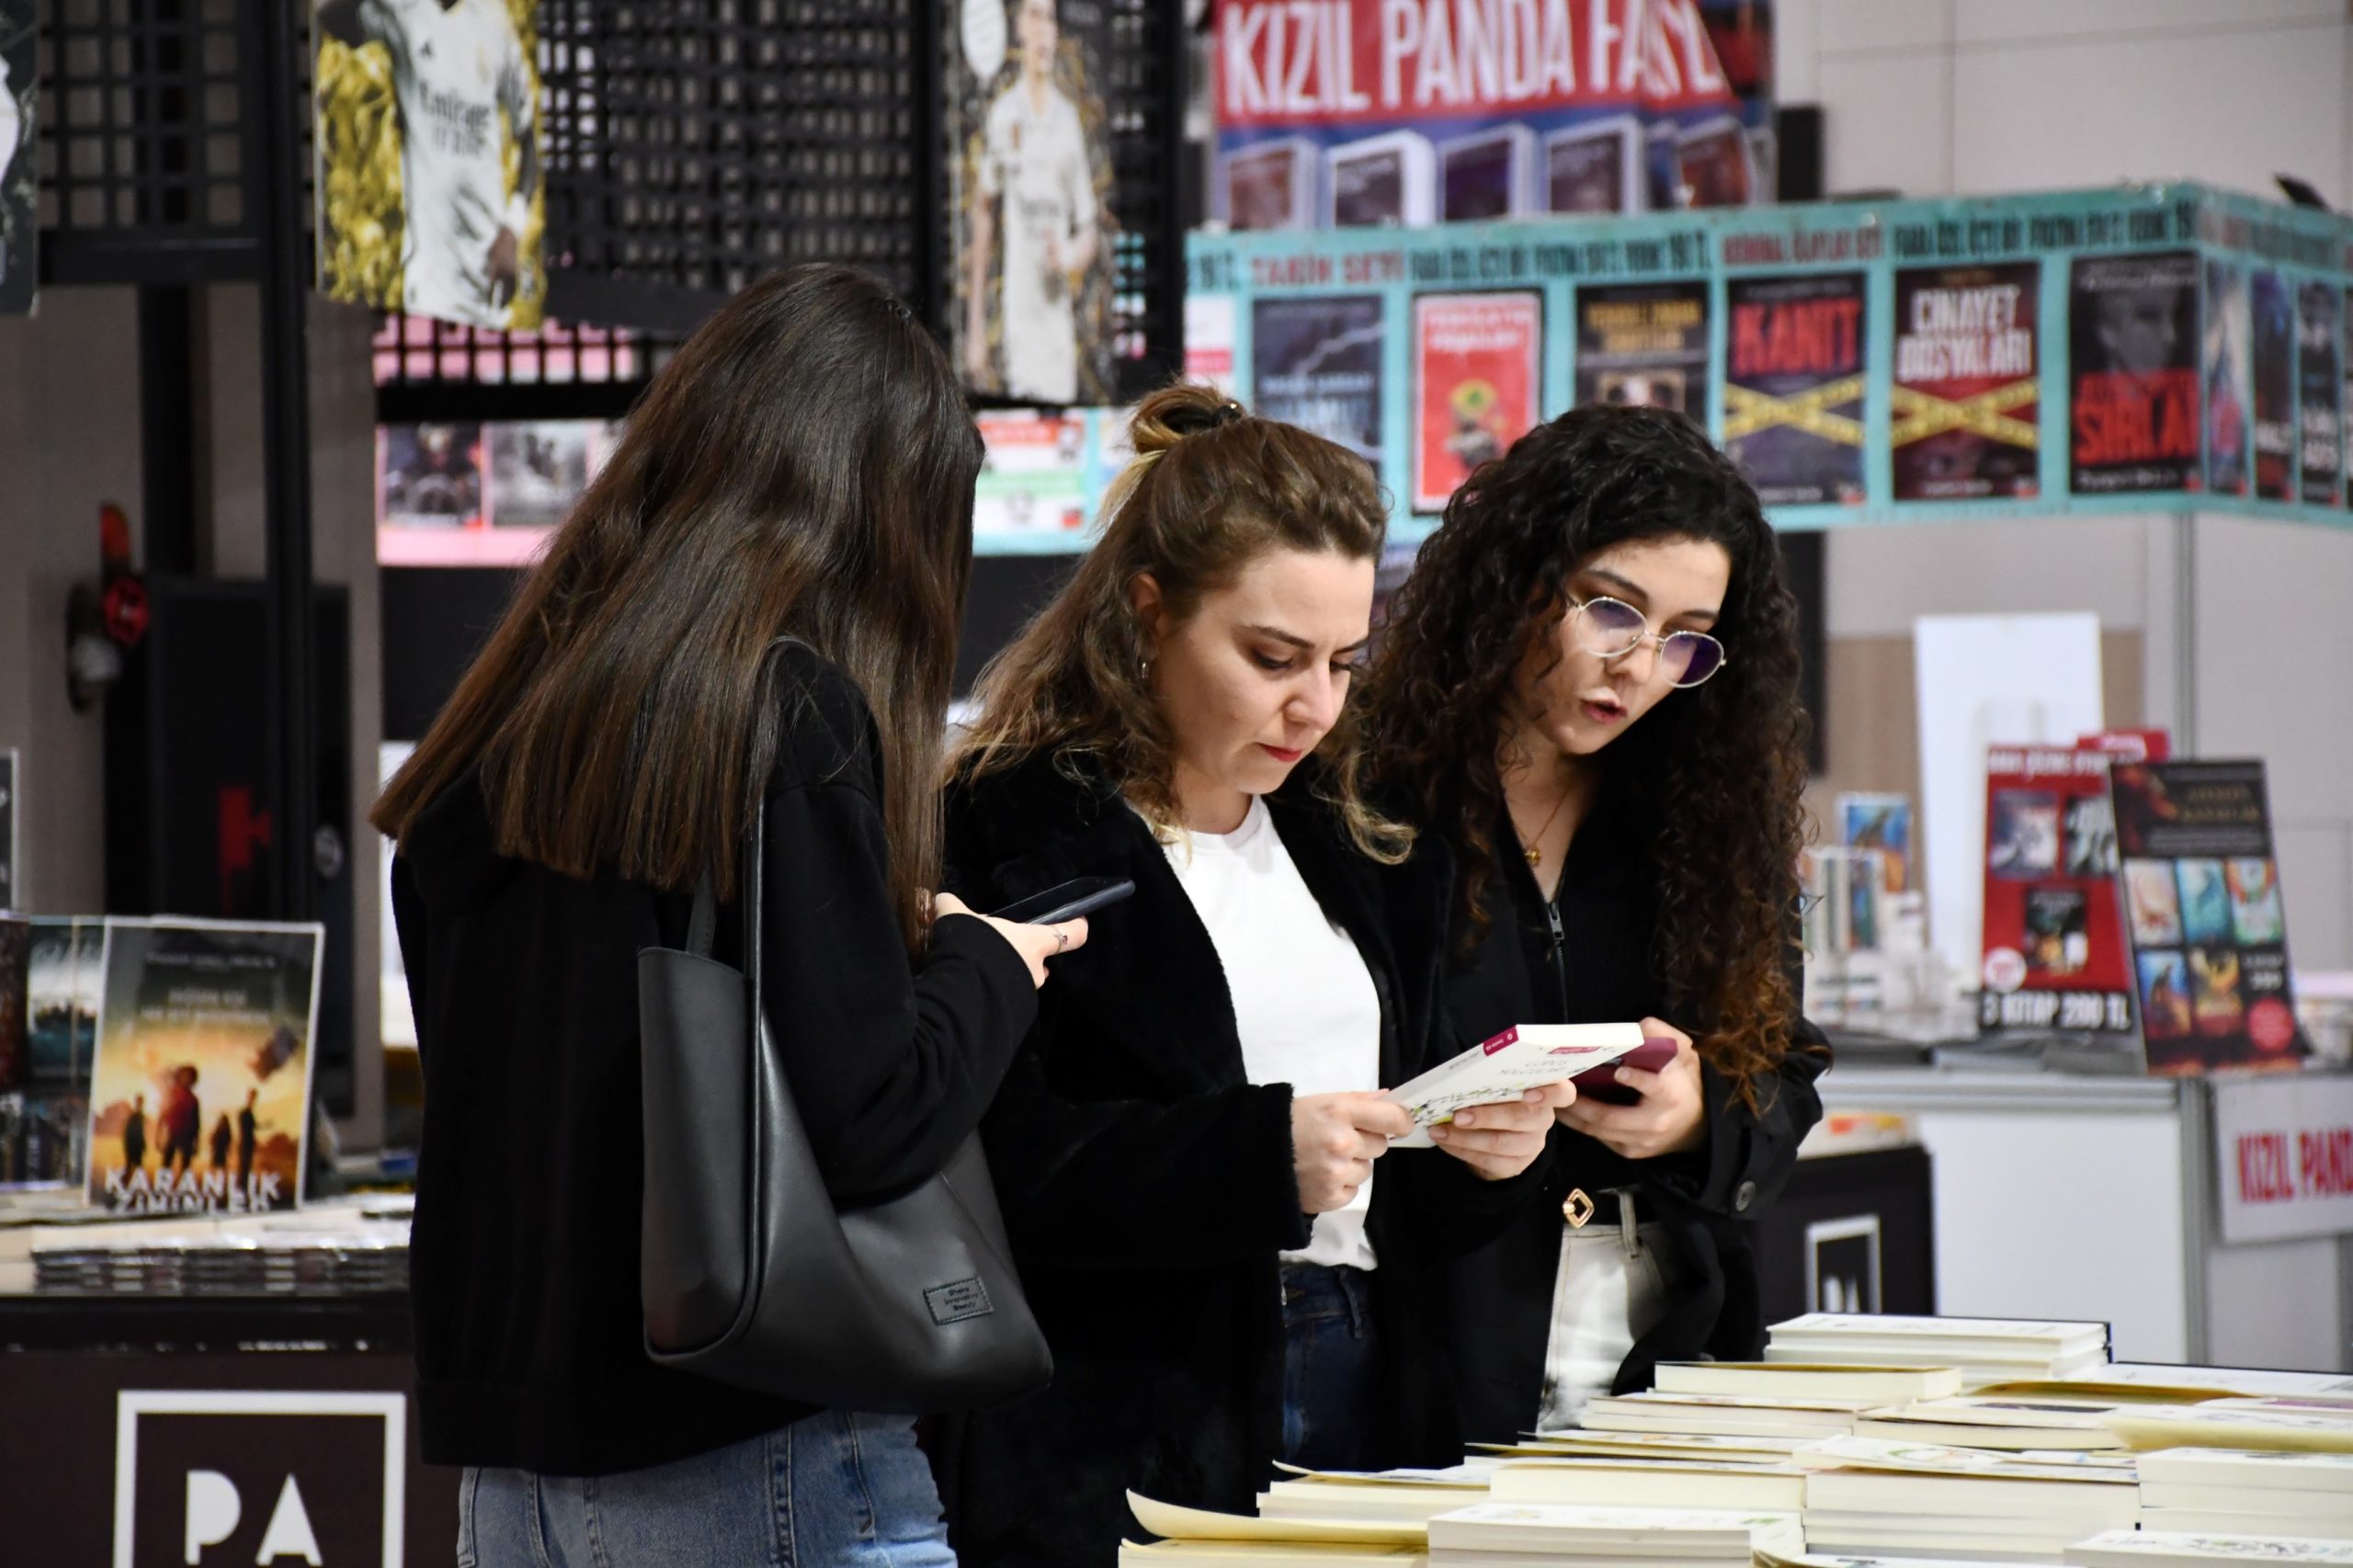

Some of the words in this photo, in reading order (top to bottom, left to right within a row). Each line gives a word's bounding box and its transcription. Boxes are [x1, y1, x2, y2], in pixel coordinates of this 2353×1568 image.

[1223, 3, 1371, 114] KIZIL
[1383, 0, 1575, 107] PANDA
[104, 1165, 282, 1201] KARANLIK
[185, 1470, 324, 1566] PA
